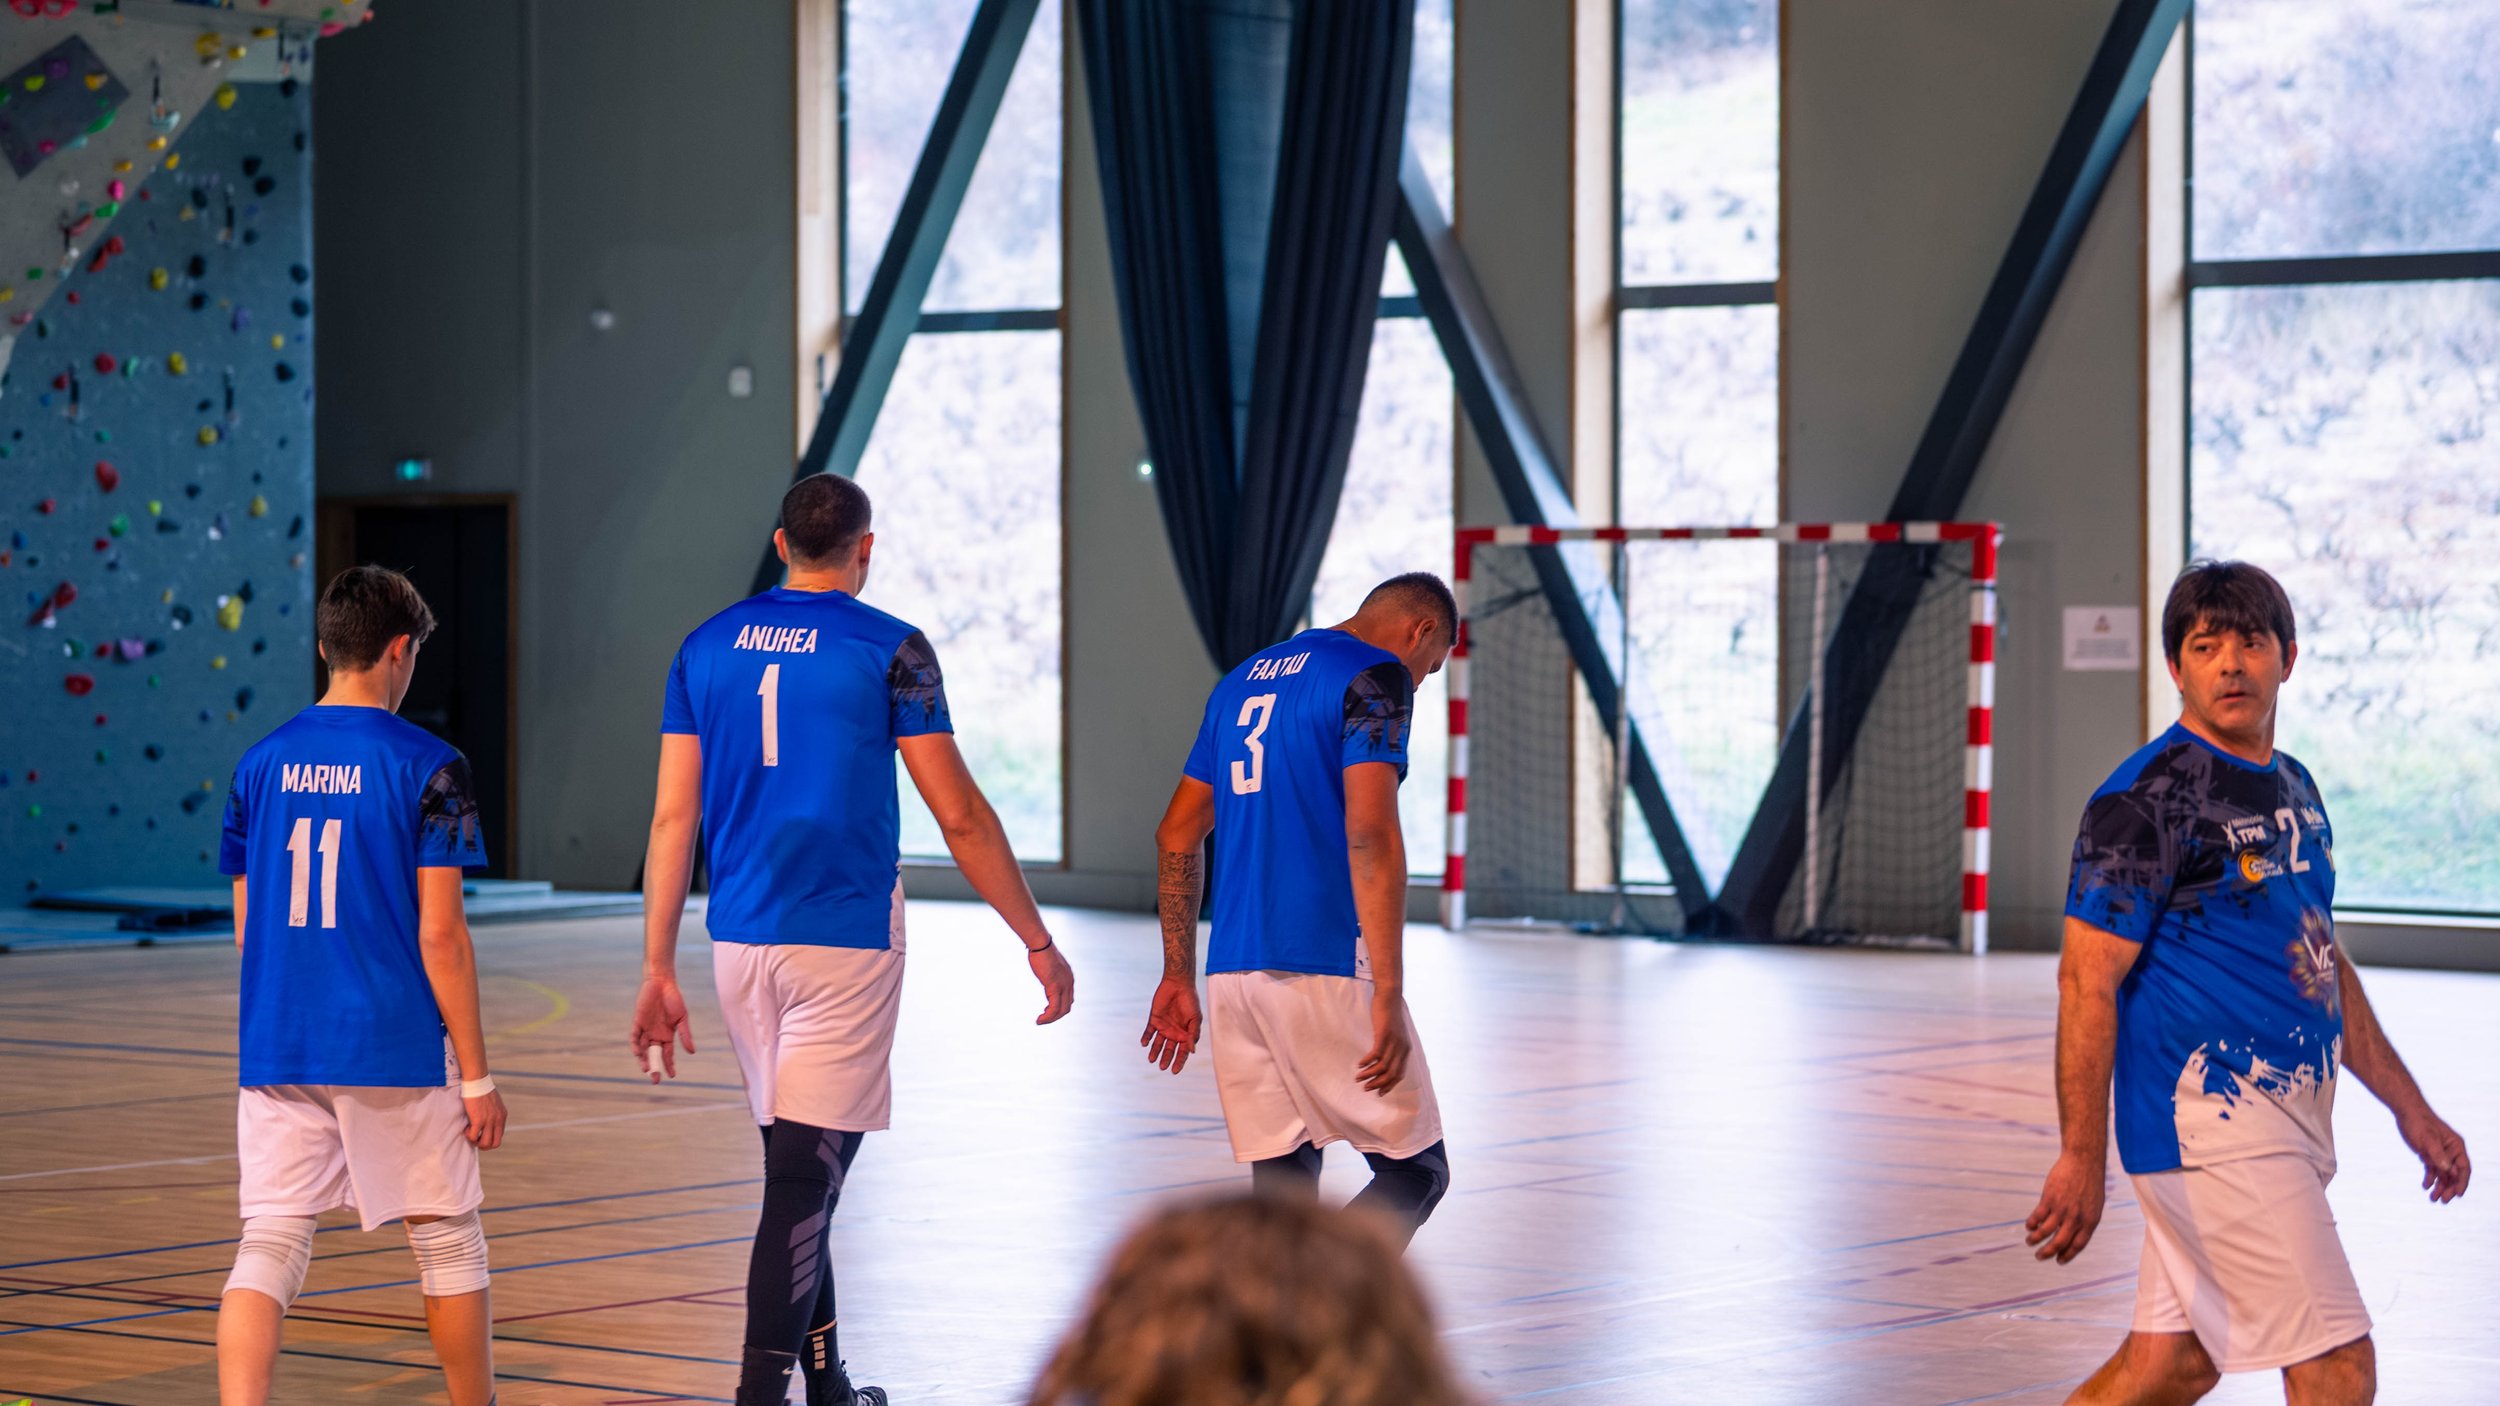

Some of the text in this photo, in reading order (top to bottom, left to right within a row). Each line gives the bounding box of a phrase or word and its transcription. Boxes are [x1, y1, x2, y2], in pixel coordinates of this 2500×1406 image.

[733, 624, 818, 653] ANUHEA
[757, 664, 780, 767] 1
[1231, 693, 1277, 795] 3
[281, 763, 361, 794] MARINA
[2237, 825, 2267, 843] TPM
[2274, 808, 2310, 873] 2
[286, 818, 342, 928] 11
